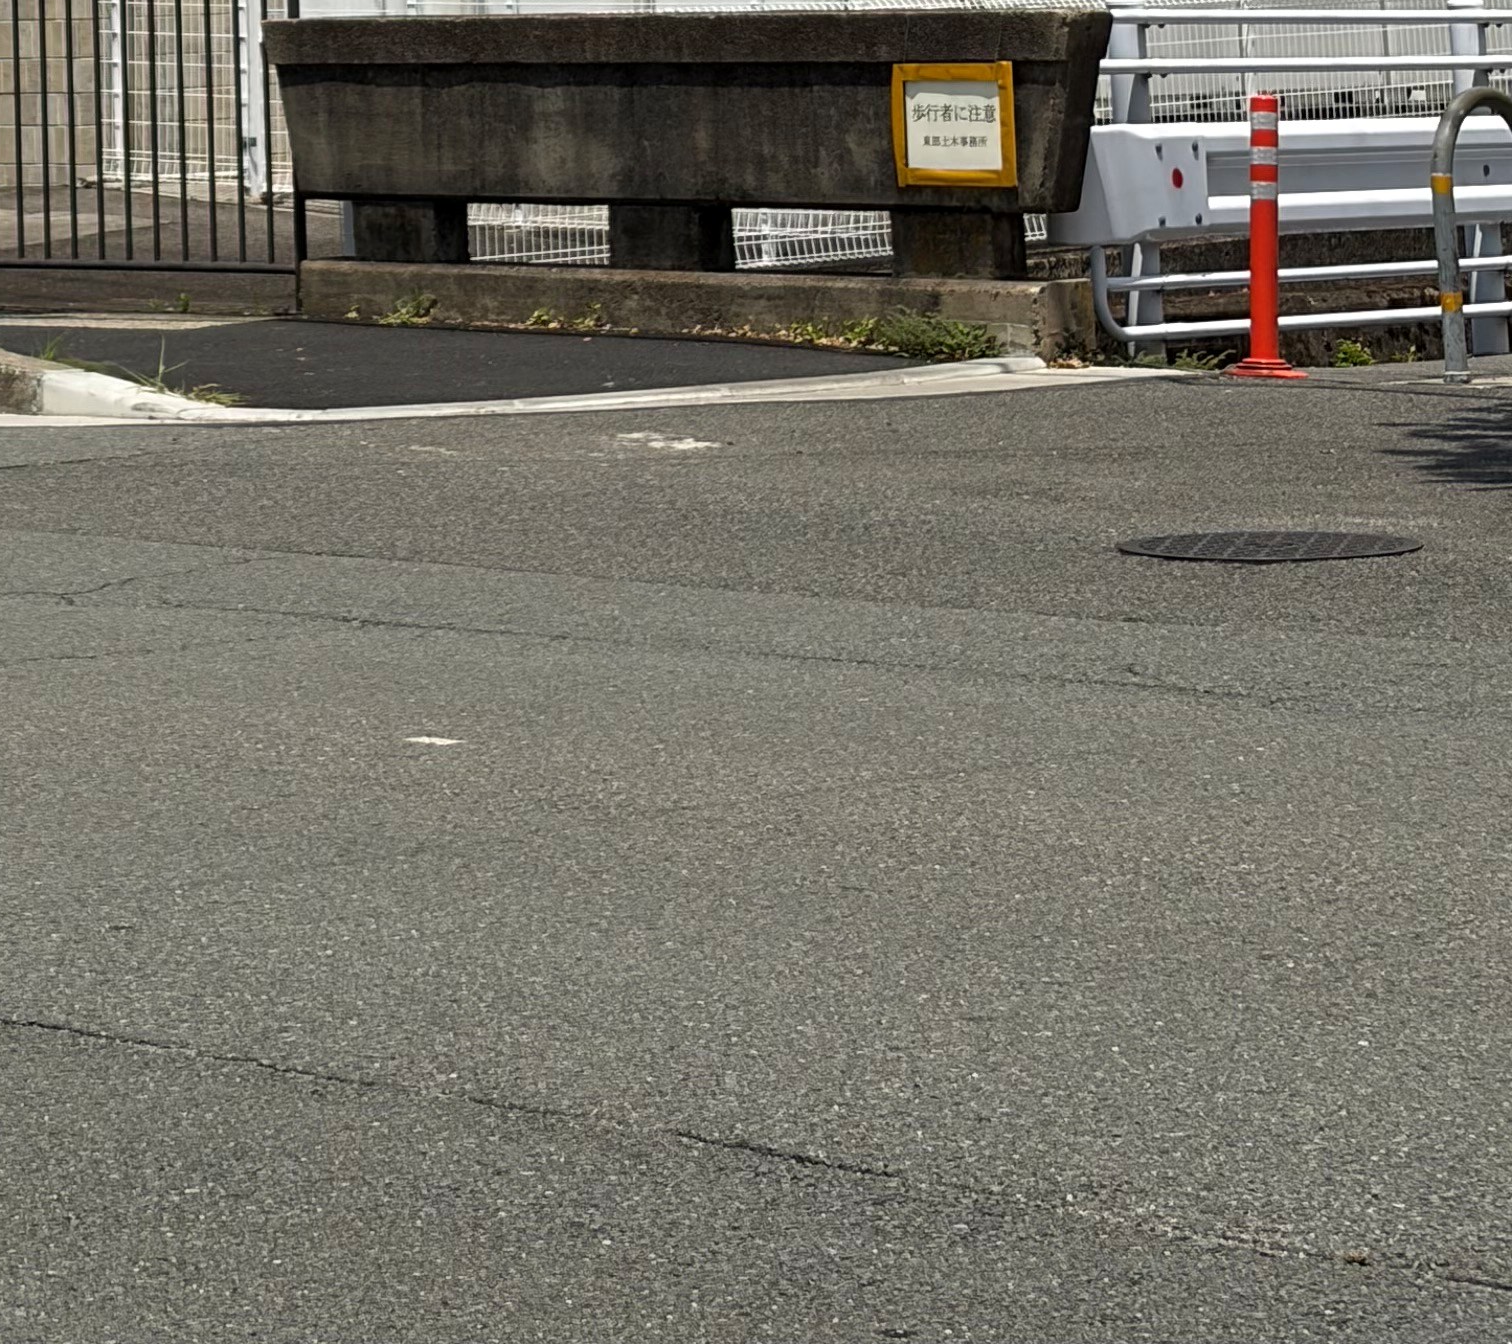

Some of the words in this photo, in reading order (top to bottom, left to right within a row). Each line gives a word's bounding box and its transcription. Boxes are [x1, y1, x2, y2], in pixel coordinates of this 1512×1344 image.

[912, 103, 996, 123] 歩行者に注意
